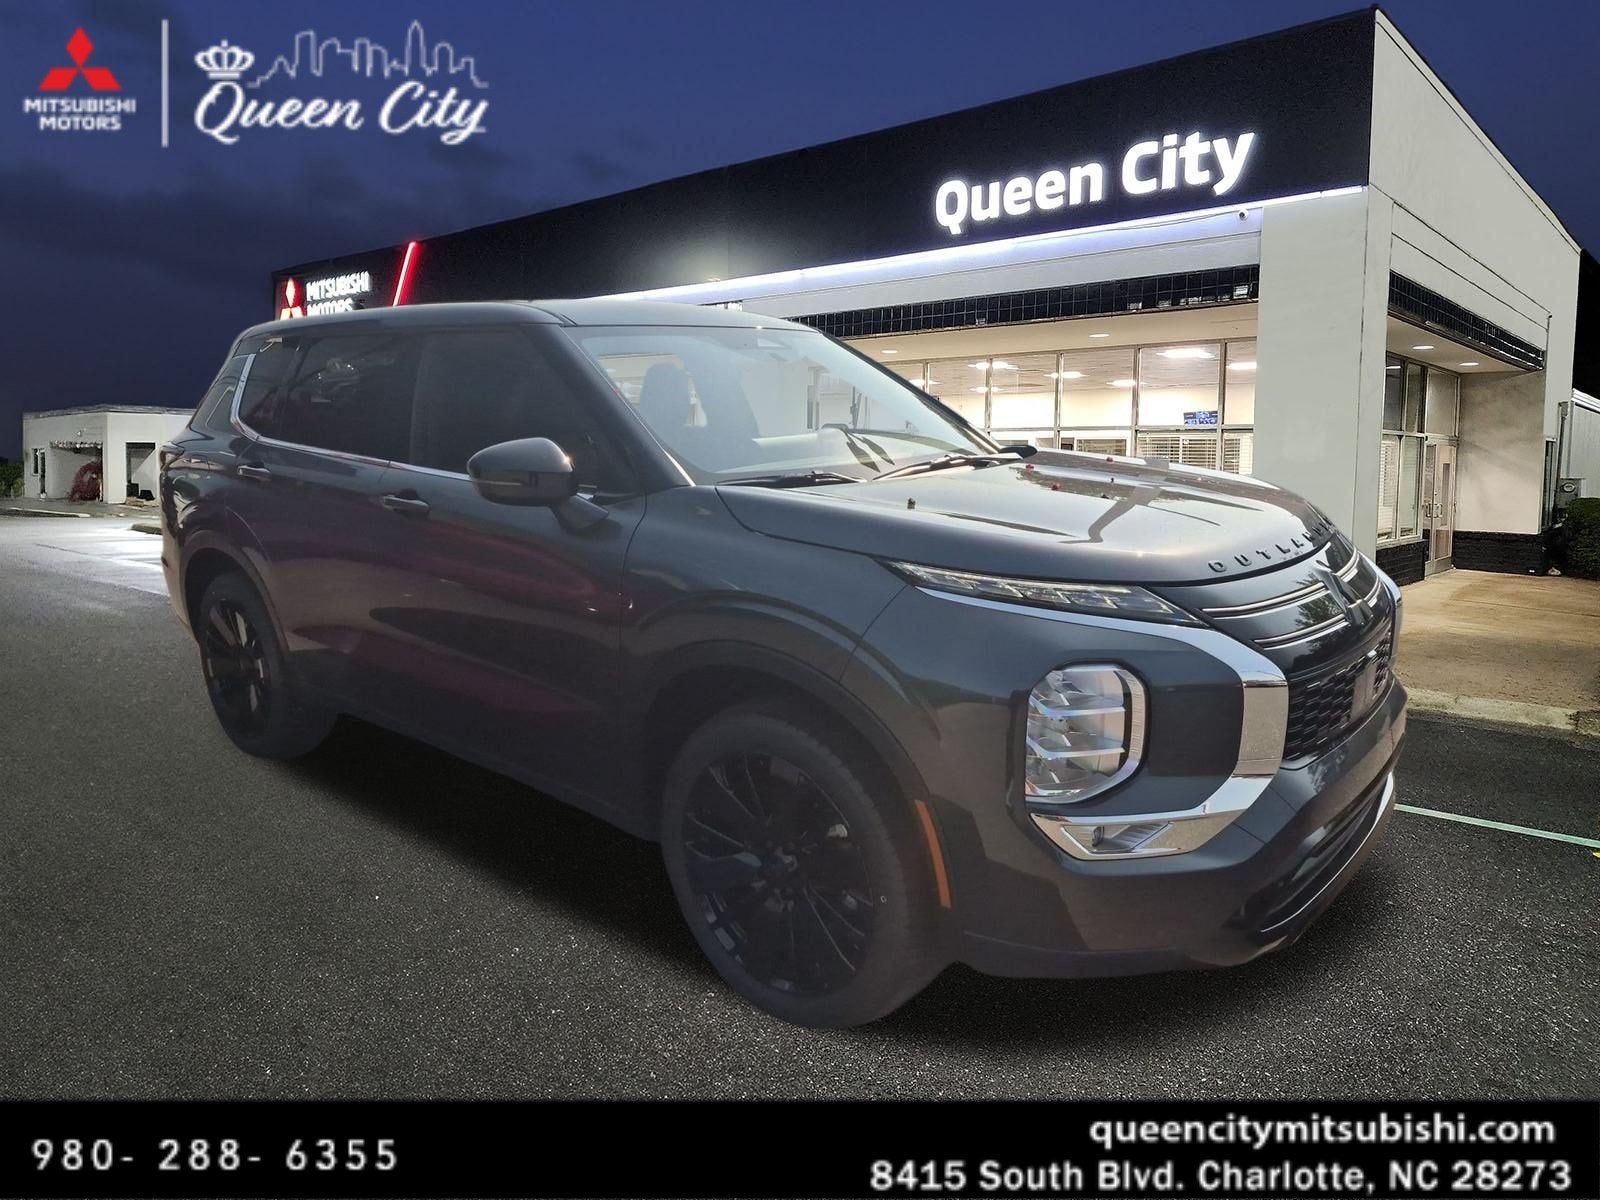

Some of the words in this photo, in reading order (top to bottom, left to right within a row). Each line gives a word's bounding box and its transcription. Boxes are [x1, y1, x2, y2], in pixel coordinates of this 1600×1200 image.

[935, 161, 1103, 235] Queen
[1121, 132, 1255, 196] City
[306, 270, 371, 302] MITSUBISHI
